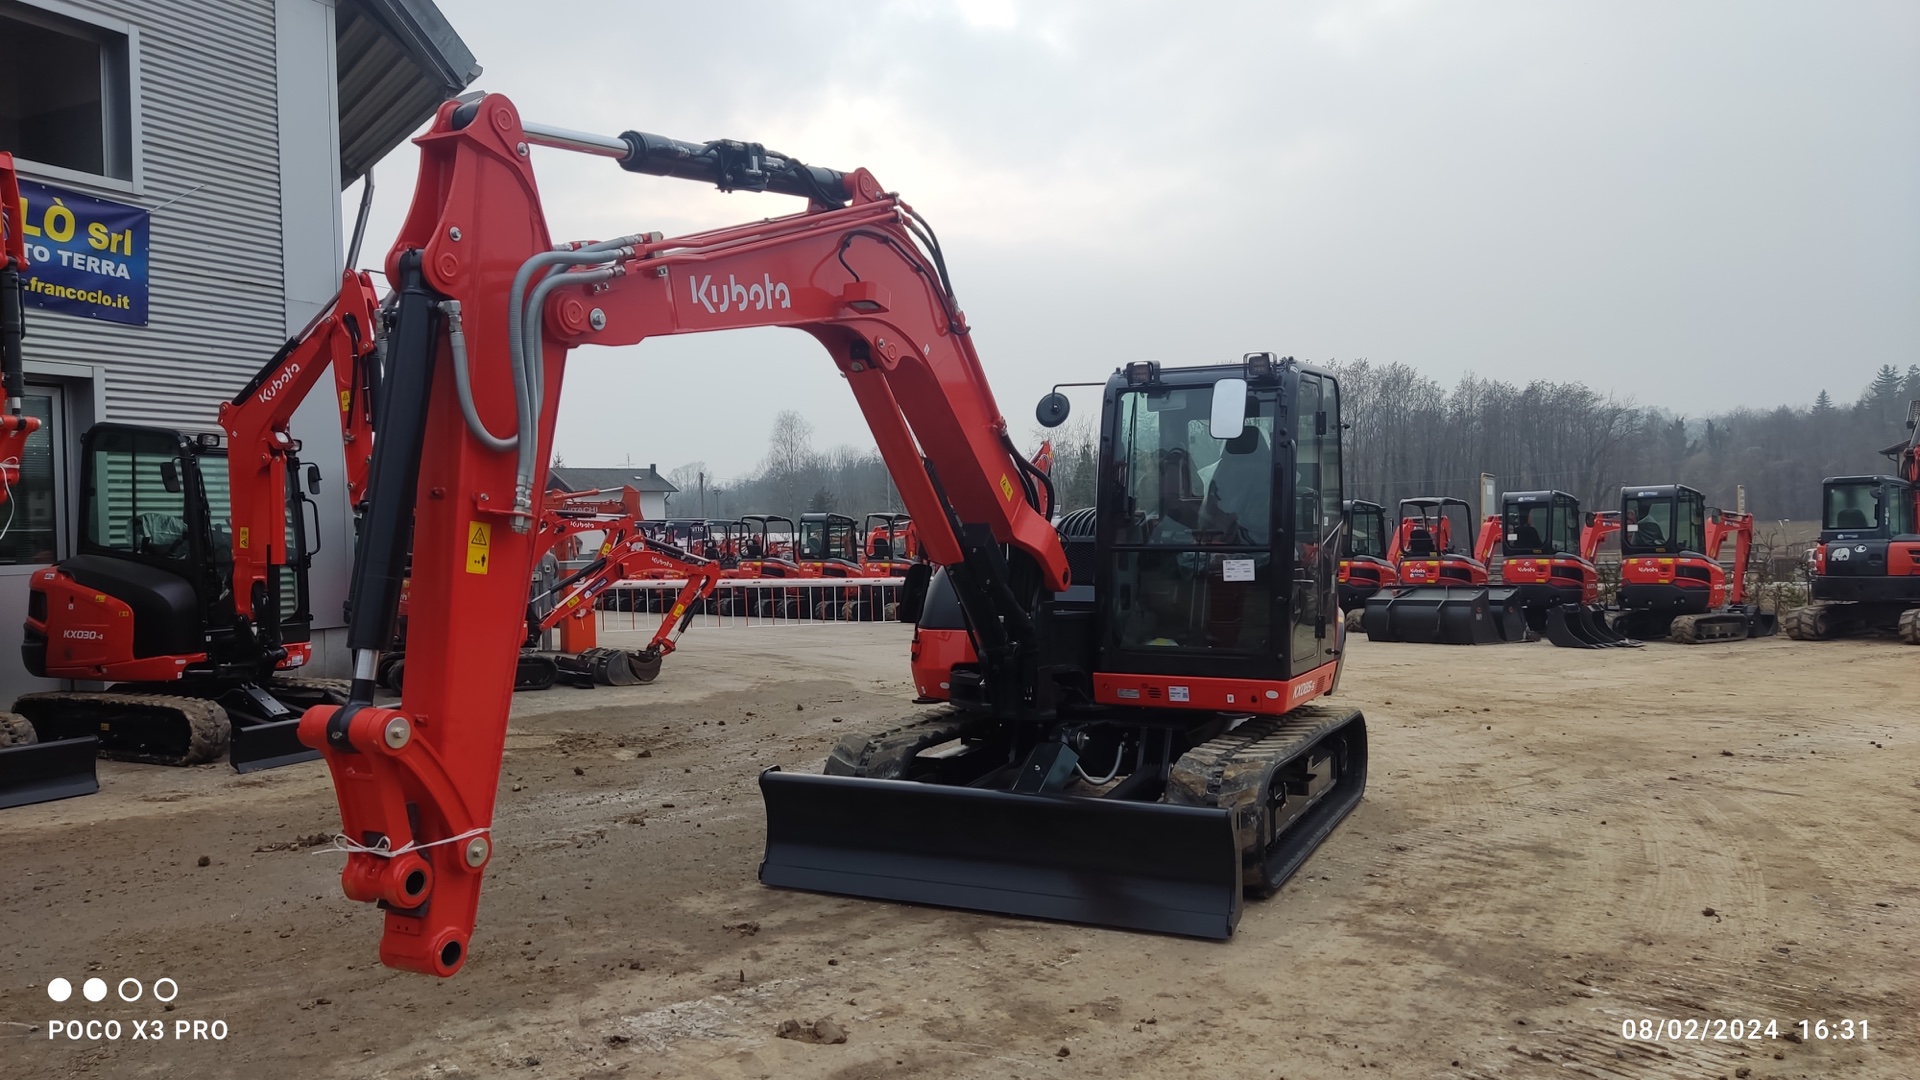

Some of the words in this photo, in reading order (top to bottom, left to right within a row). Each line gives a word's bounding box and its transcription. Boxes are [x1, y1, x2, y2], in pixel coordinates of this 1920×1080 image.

[87, 222, 132, 257] Srl
[57, 250, 131, 280] TERRA
[689, 273, 791, 314] Kubota
[258, 363, 300, 403] Kubota
[570, 520, 595, 529] Kubota
[651, 556, 673, 568] Kubota
[63, 630, 103, 640] KX030-4
